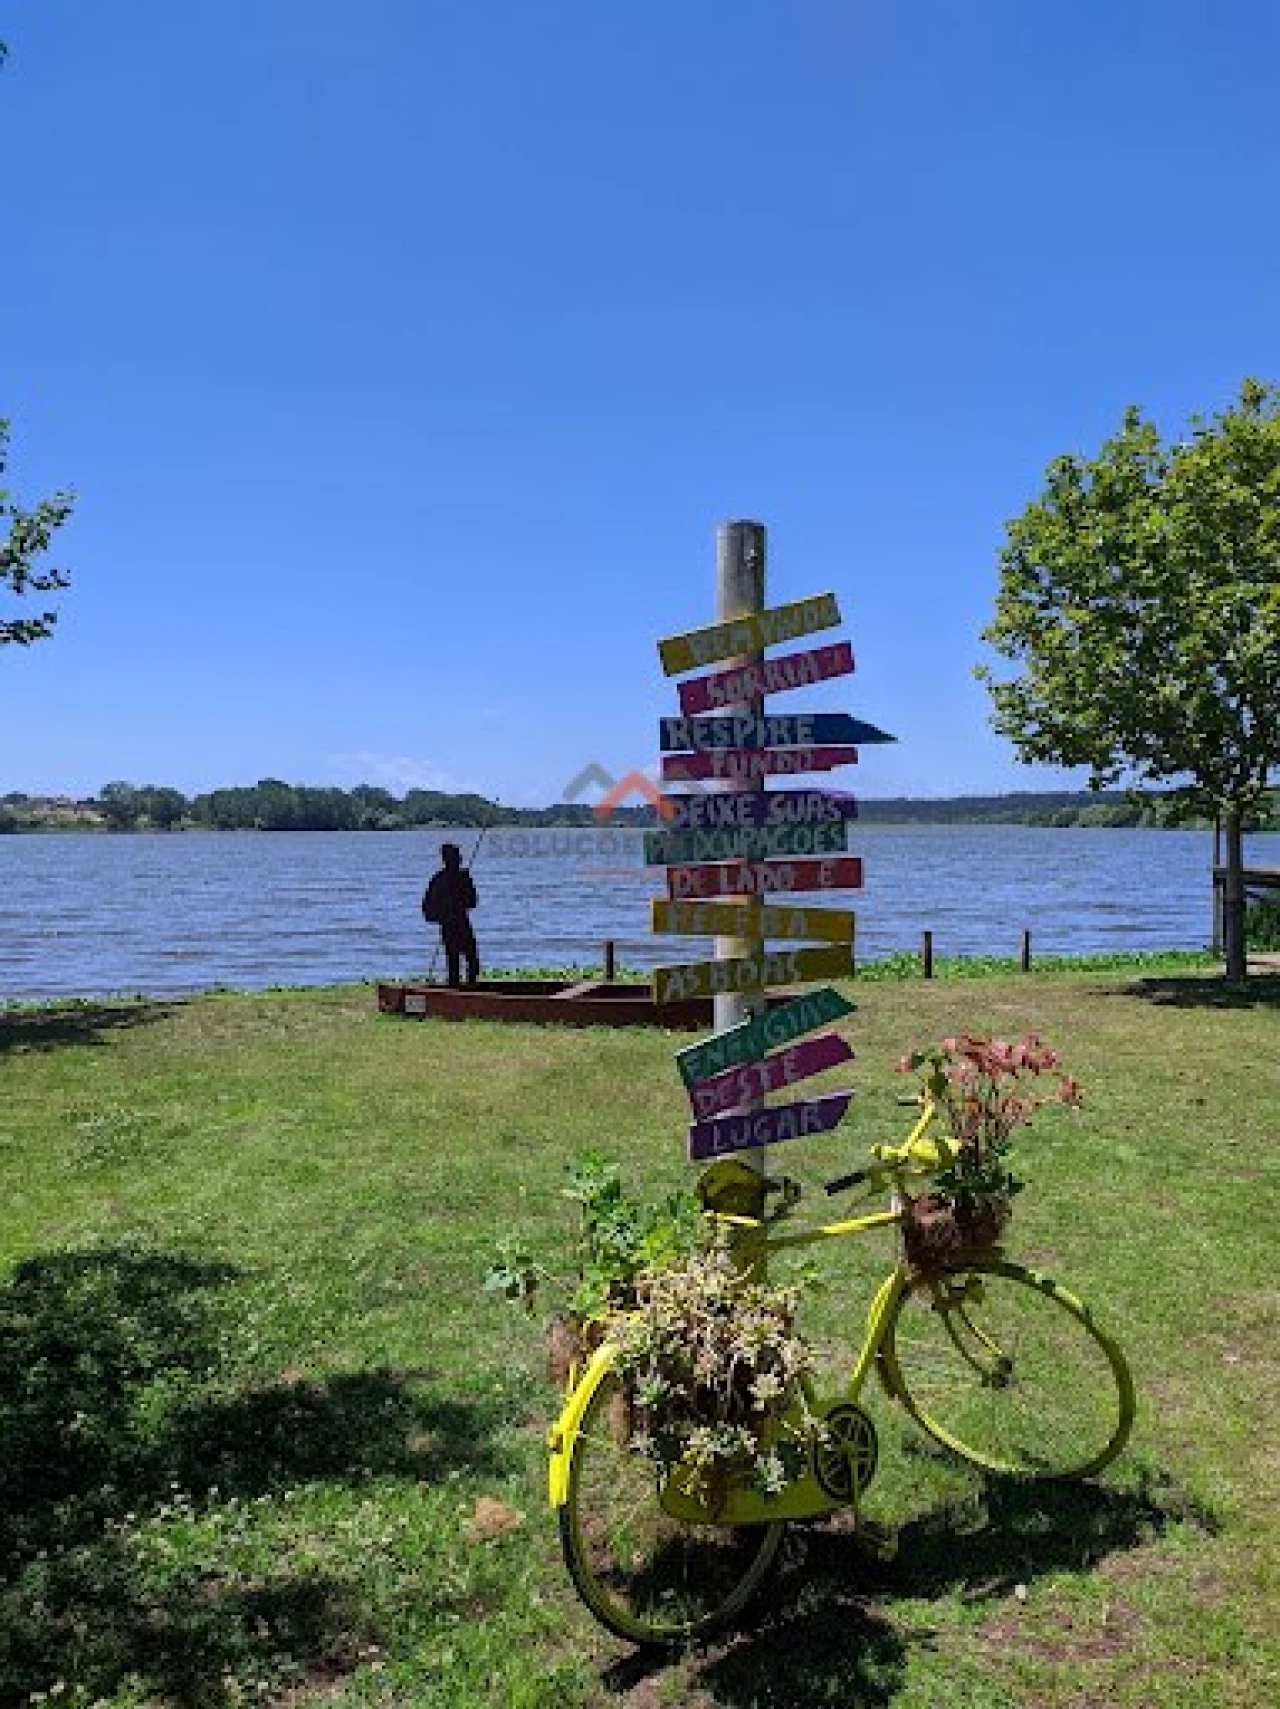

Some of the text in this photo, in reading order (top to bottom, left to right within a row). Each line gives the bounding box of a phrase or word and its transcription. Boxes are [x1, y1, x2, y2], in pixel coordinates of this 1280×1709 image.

[667, 716, 815, 749] RESPIRE
[765, 794, 841, 825] SUAS
[720, 863, 795, 891] LADO
[820, 861, 835, 887] E
[696, 1056, 801, 1116] DESTE
[713, 1104, 823, 1150] LUGAR
